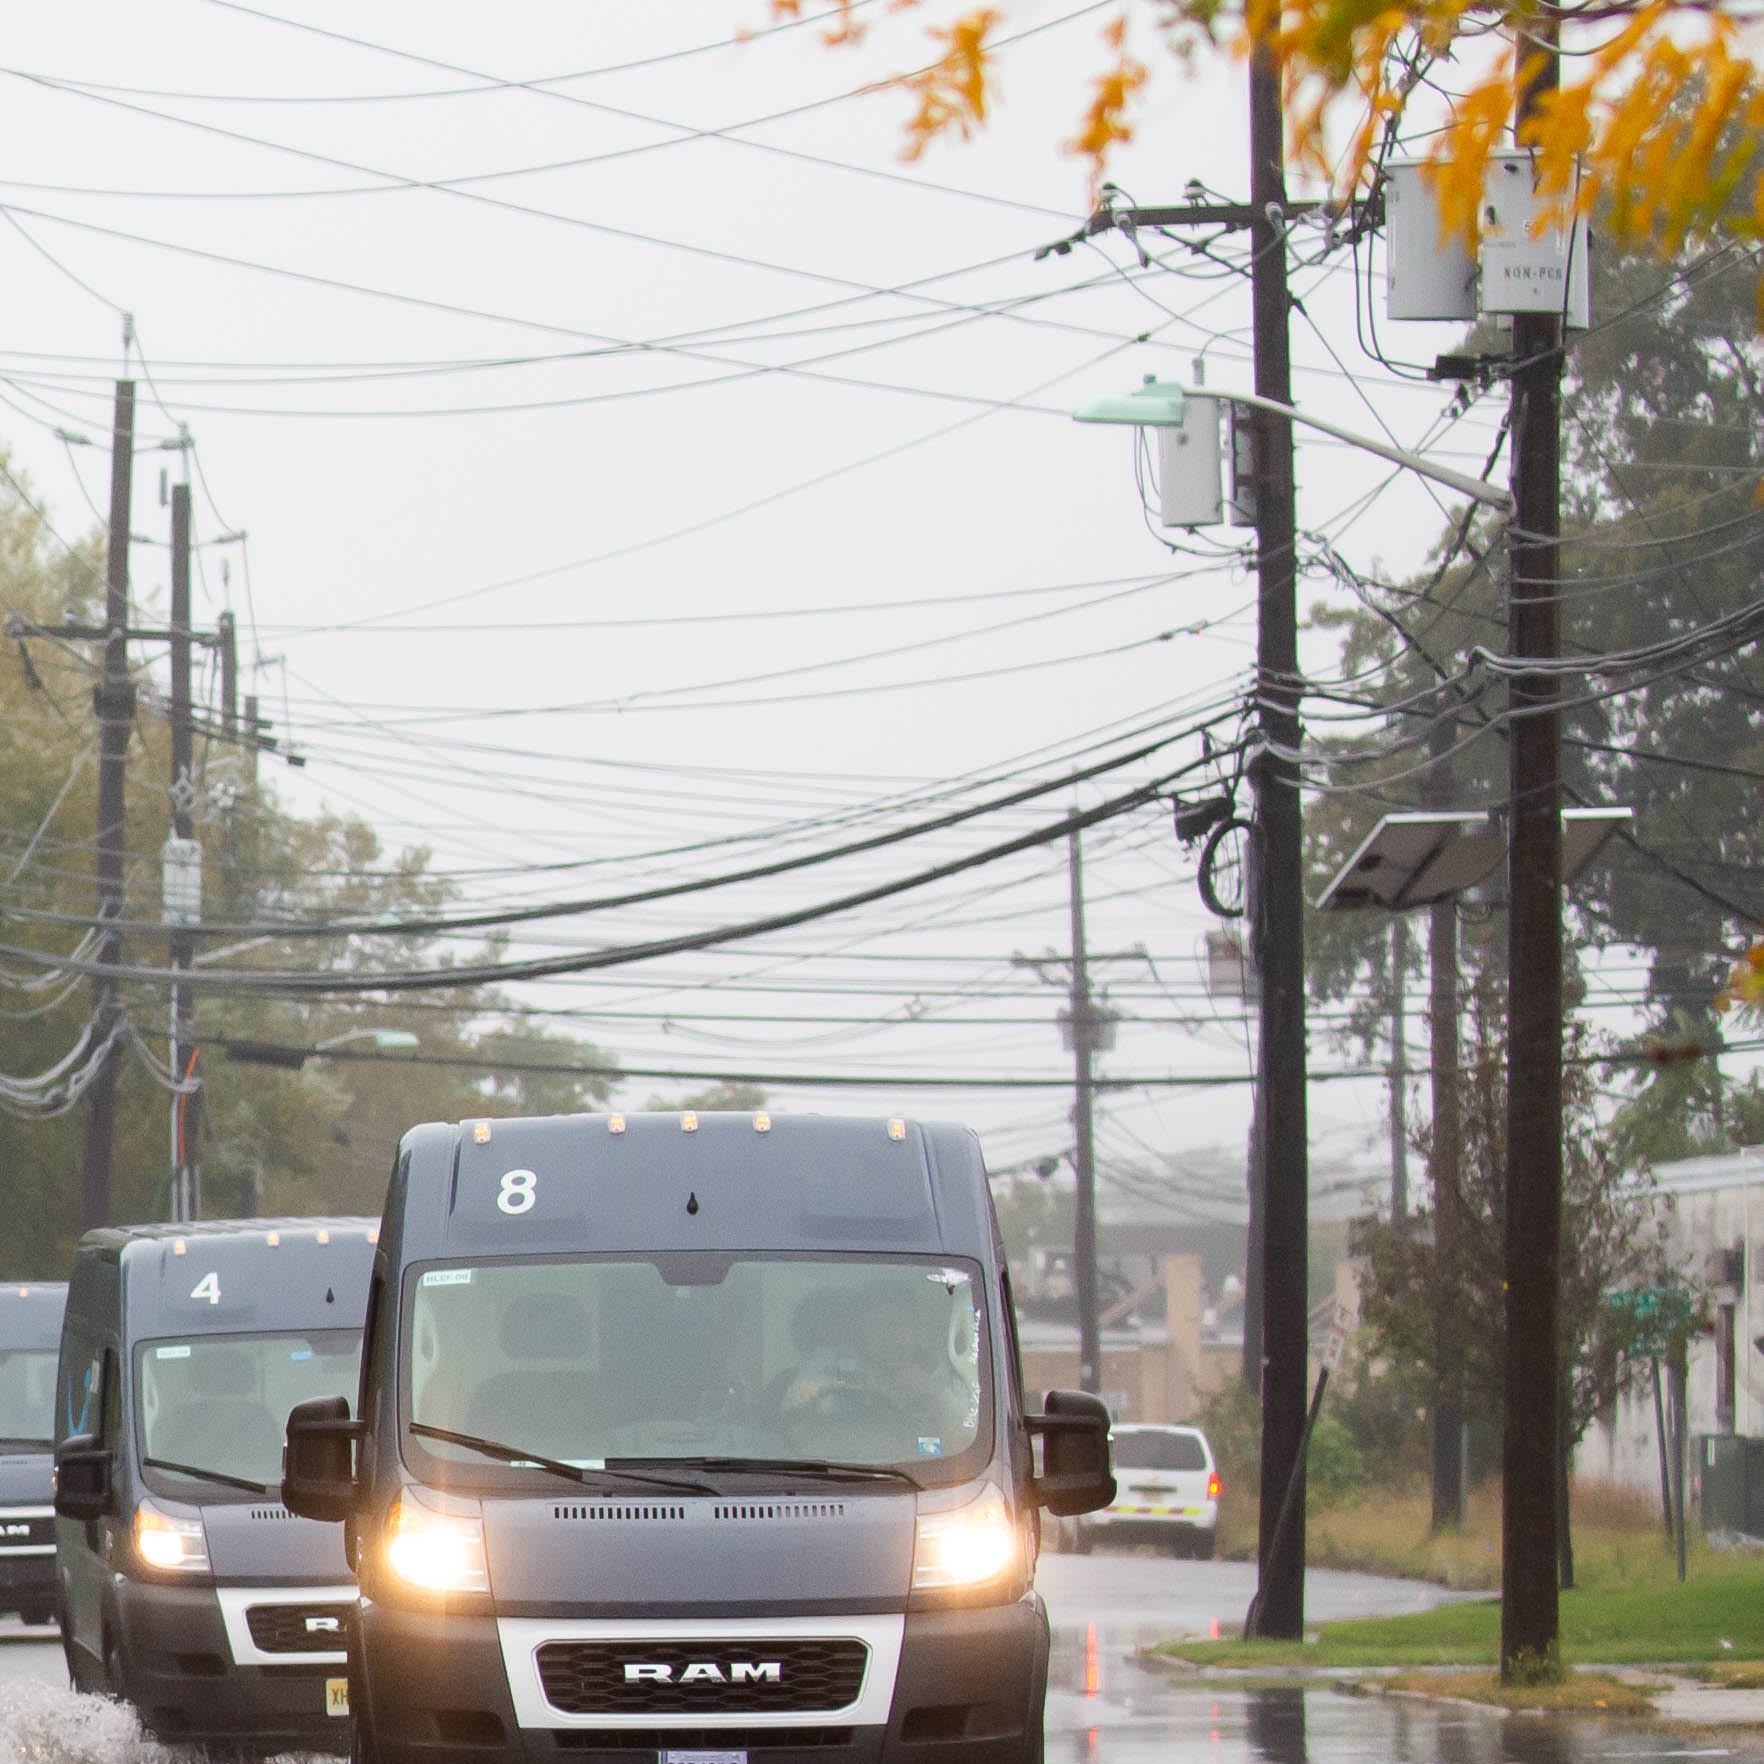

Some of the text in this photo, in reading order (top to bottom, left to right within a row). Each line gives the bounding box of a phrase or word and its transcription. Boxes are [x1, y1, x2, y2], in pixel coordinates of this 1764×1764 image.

[497, 1169, 537, 1215] 8
[190, 1271, 222, 1305] 4
[624, 1662, 782, 1684] RAM
